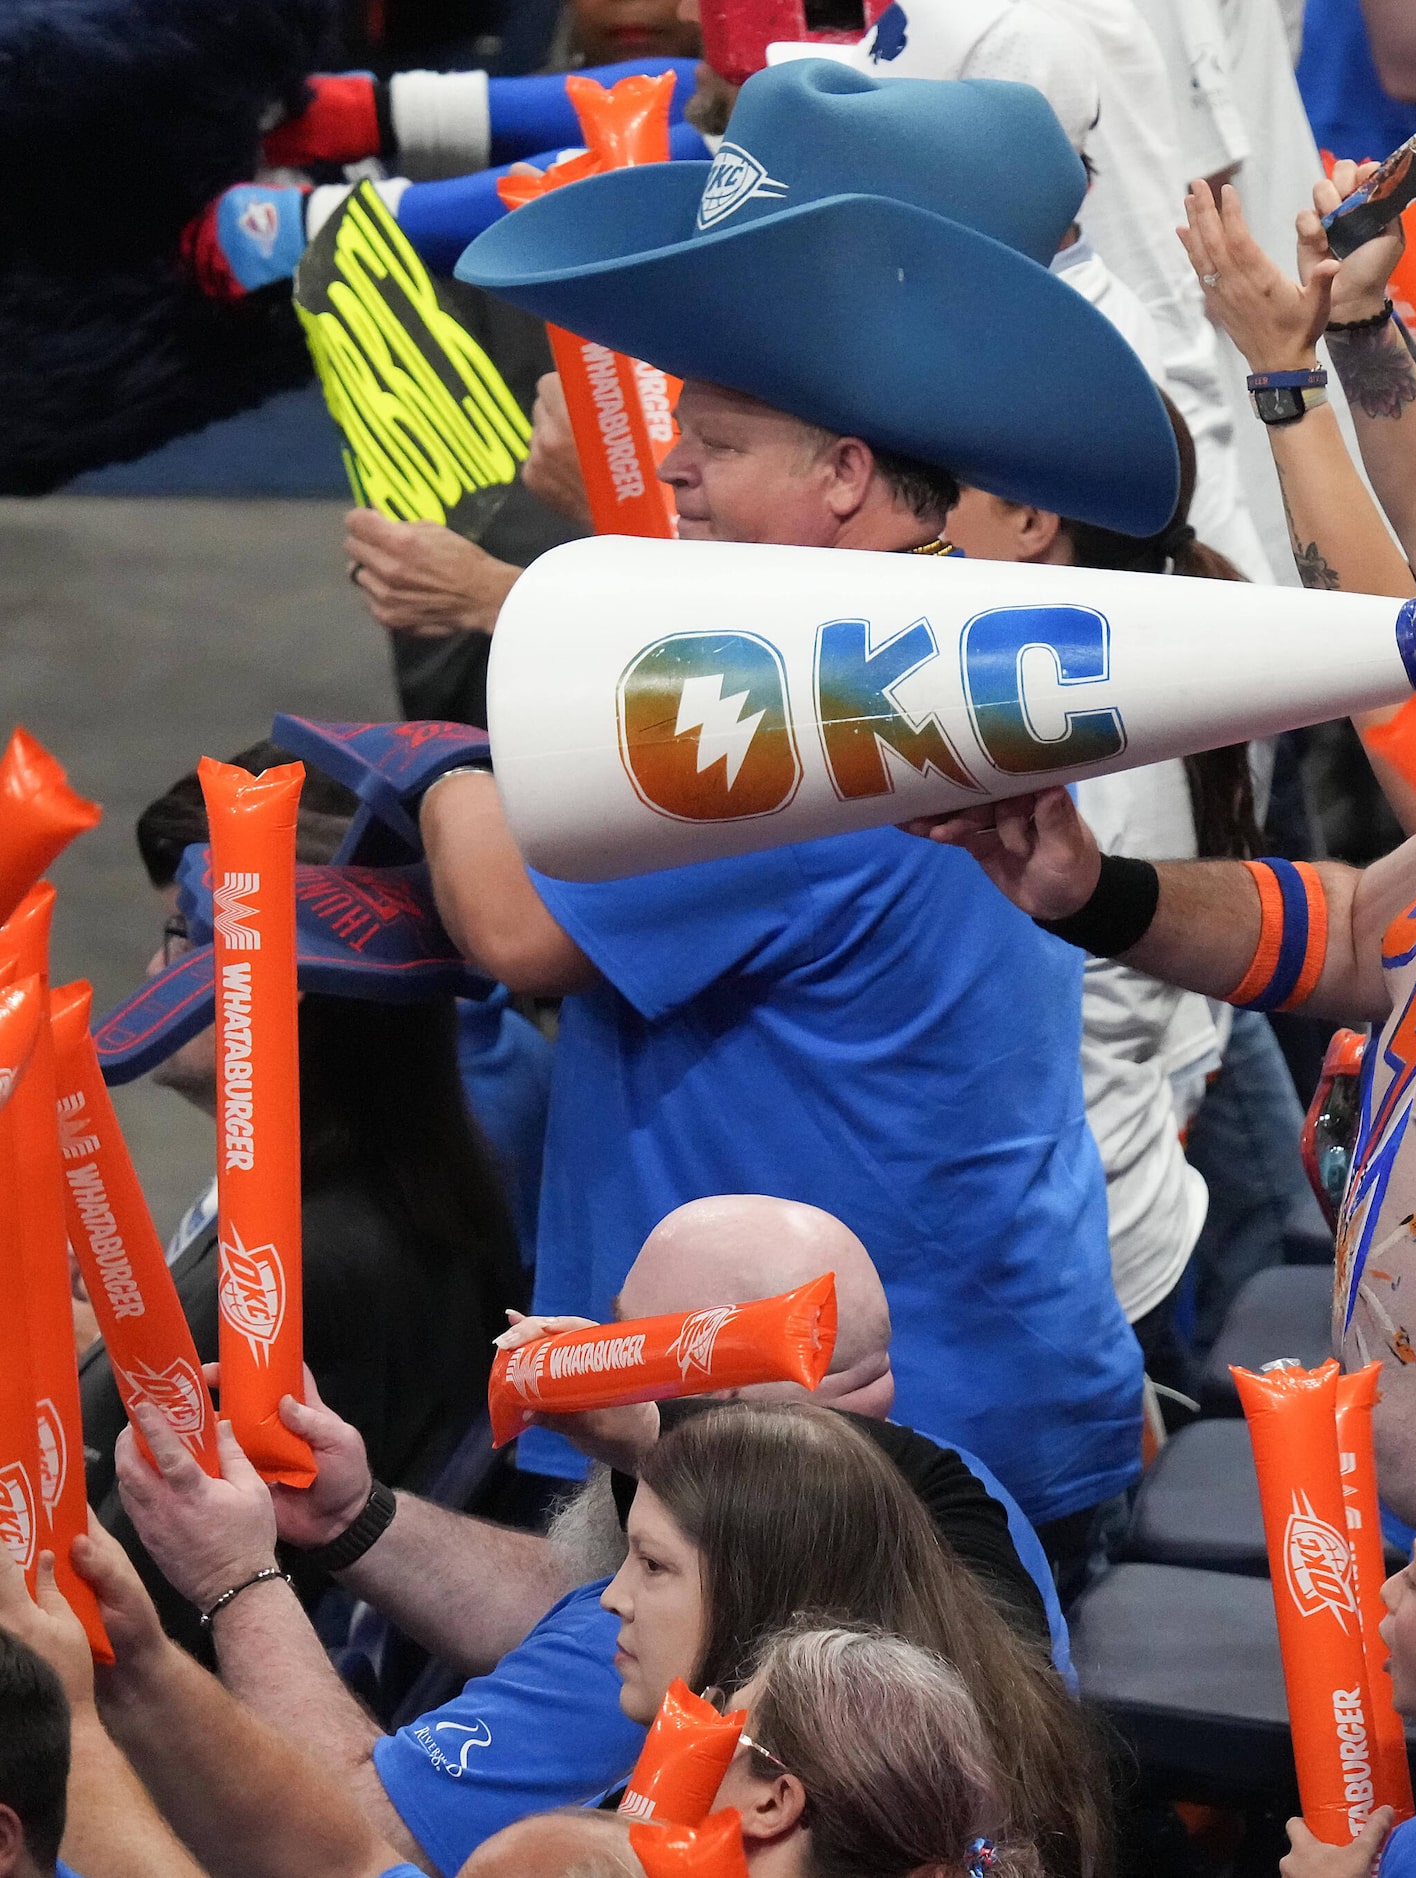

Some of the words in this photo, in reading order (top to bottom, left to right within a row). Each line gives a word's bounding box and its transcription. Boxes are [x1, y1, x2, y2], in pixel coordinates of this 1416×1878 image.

[614, 602, 1128, 825] OKC
[222, 961, 255, 1171] WHATABURGER
[66, 1162, 146, 1320] WHATABURGER
[225, 1249, 271, 1321] OKC
[550, 1334, 647, 1379] WHATABURGER
[1296, 1537, 1351, 1608] OKC
